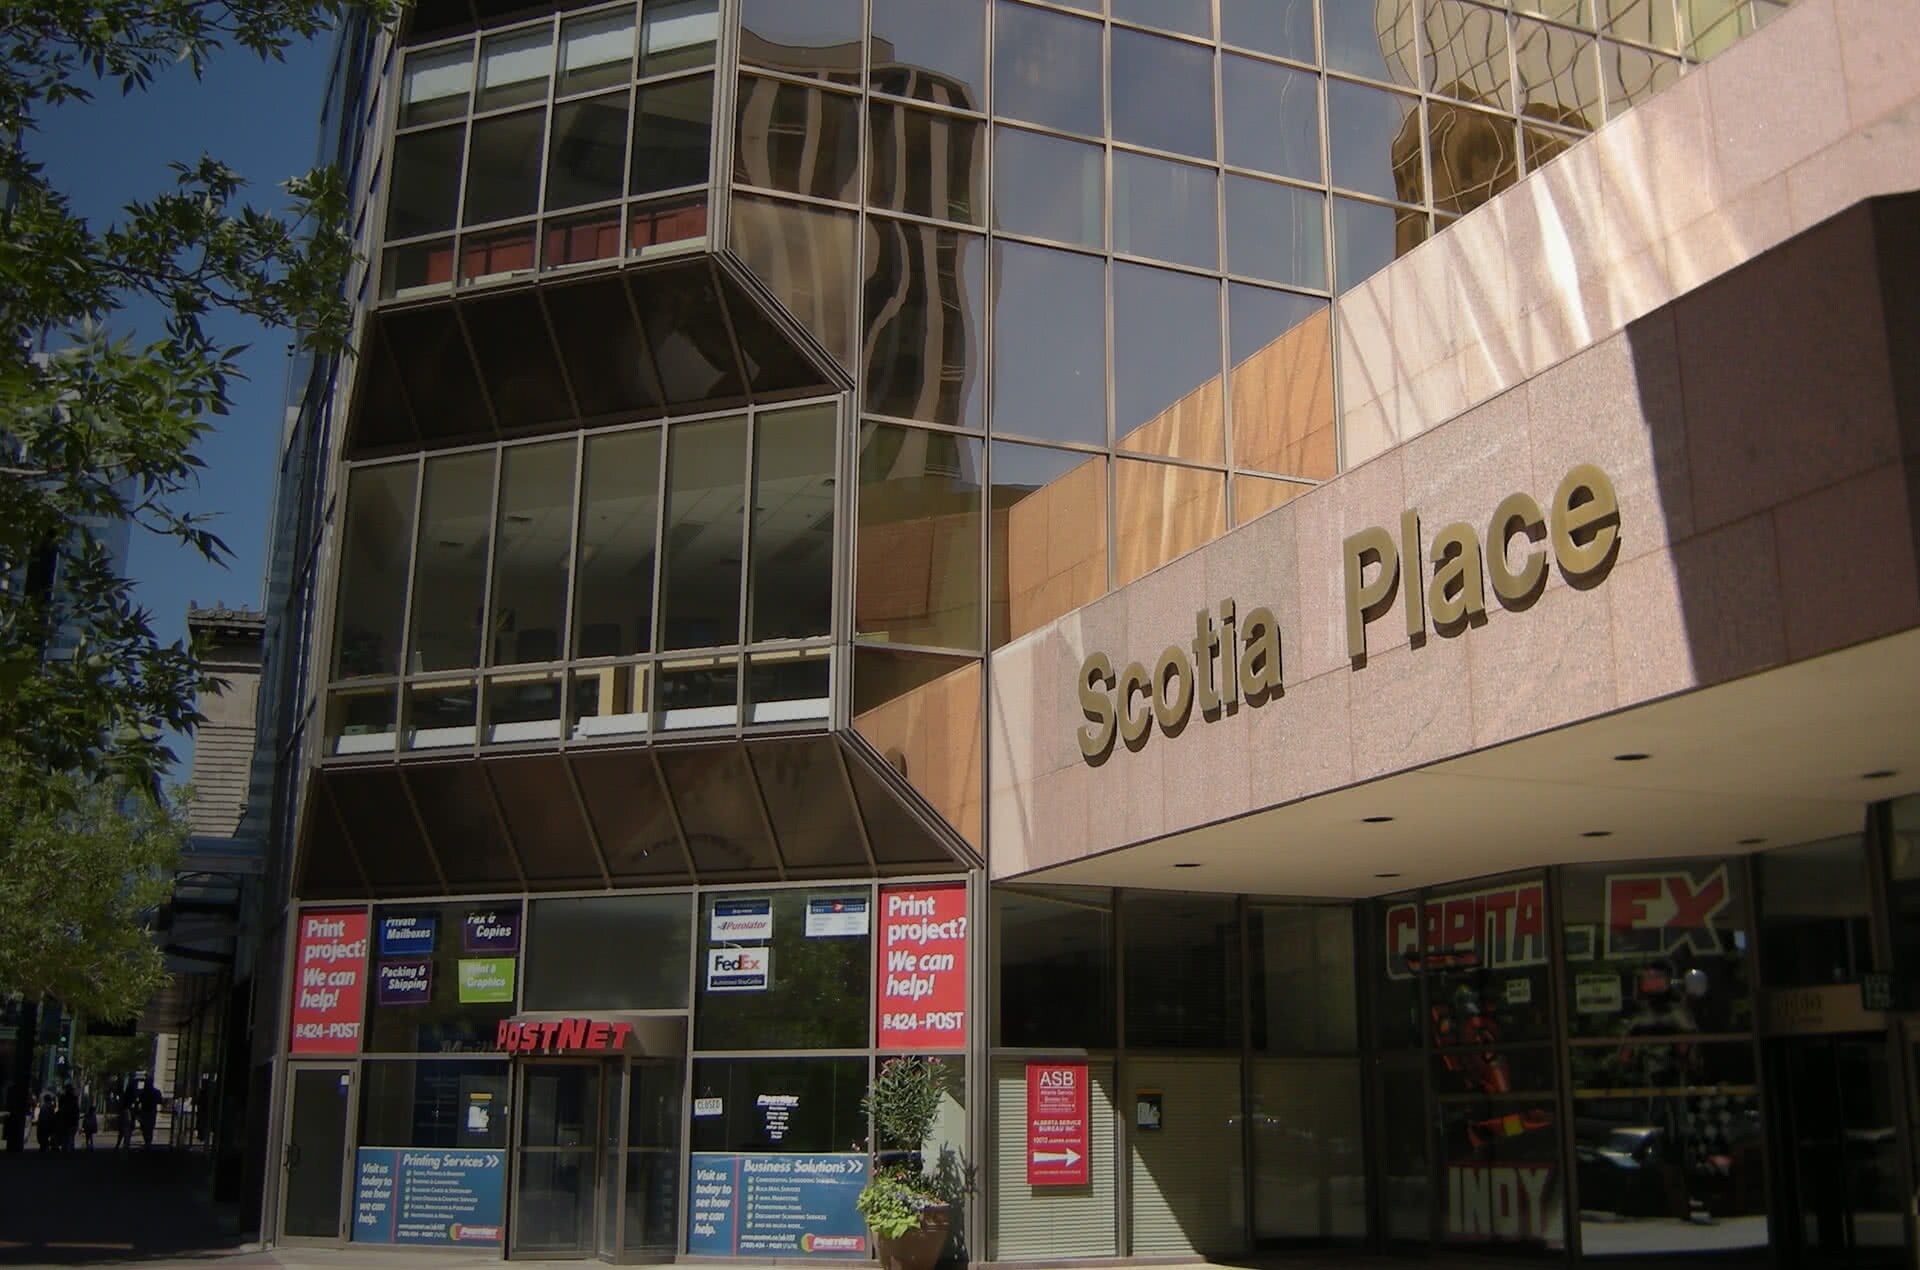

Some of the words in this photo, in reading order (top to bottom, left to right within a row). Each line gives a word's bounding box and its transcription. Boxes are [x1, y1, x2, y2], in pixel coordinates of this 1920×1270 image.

[1077, 597, 1284, 765] Scotia
[1342, 462, 1622, 668] Place
[888, 894, 936, 917] Print
[305, 918, 345, 938] Print
[476, 925, 512, 939] Copies
[726, 920, 767, 930] Purolator
[887, 916, 967, 947] project?
[386, 928, 431, 940] Mailboxes
[714, 953, 760, 971] FedEx
[888, 949, 917, 972] We
[919, 953, 954, 971] can
[303, 967, 326, 986] We
[327, 970, 356, 986] can
[381, 966, 417, 978] Packing
[388, 977, 428, 991] Shipping
[885, 972, 935, 1001] help!
[300, 989, 339, 1012] help!
[1040, 1071, 1074, 1086] ASB
[696, 1100, 721, 1110] CLOSED
[402, 1153, 441, 1169] Printing
[443, 1154, 484, 1167] Services
[744, 1159, 791, 1173] Business
[794, 1159, 846, 1173] Solutions
[362, 1163, 379, 1174] Visit
[695, 1169, 715, 1181] Visit
[715, 1171, 727, 1181] us
[361, 1176, 383, 1188] today
[384, 1178, 393, 1187] to
[695, 1183, 721, 1196] today
[722, 1184, 732, 1195] to
[695, 1199, 710, 1208] see
[710, 1197, 731, 1208] how
[1447, 1163, 1554, 1236] INDY
[695, 1212, 708, 1221] we
[708, 1212, 725, 1221] can
